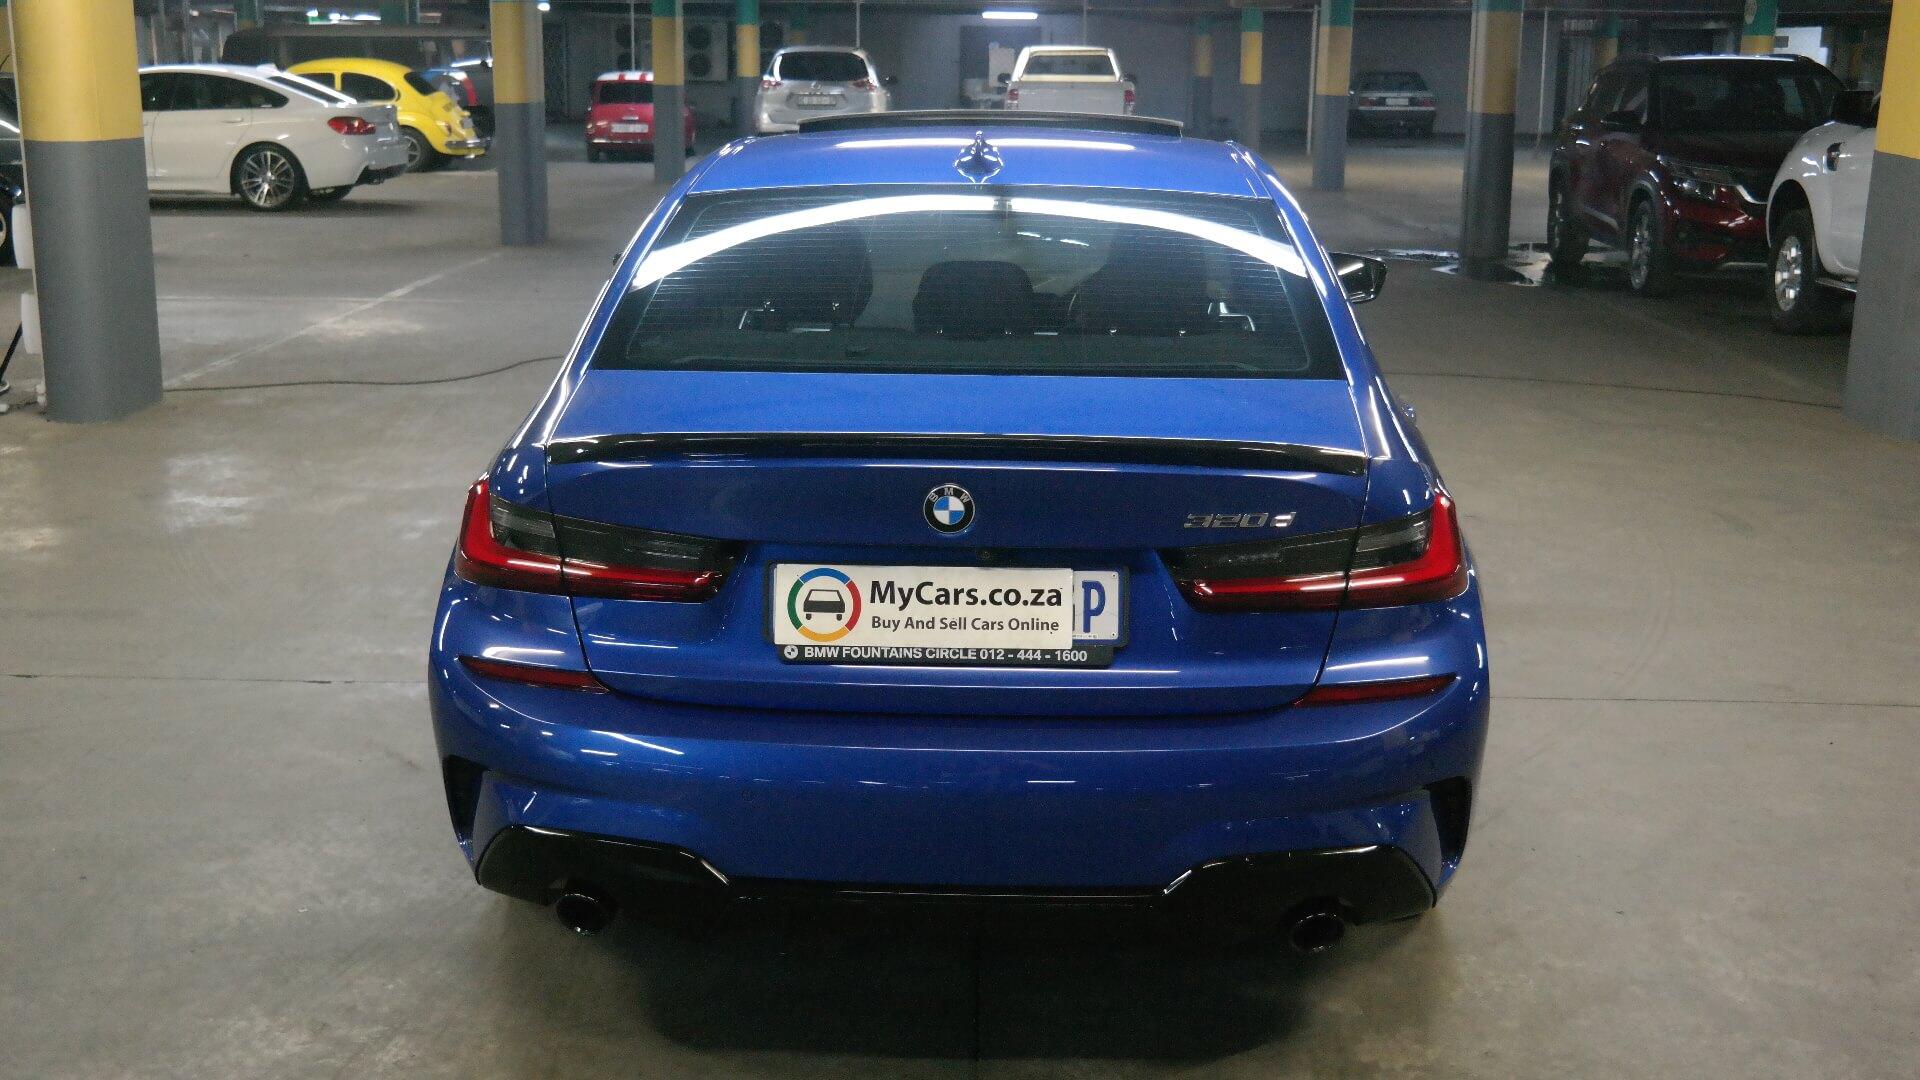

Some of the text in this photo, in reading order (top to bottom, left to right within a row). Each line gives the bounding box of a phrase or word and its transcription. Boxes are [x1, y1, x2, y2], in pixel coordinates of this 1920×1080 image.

[929, 487, 970, 502] BMW
[1184, 511, 1297, 528] 320d
[870, 580, 1062, 611] MyCars.co.za
[871, 616, 1060, 632] Buy And Sell Cars Online
[804, 646, 839, 658] BMW
[842, 646, 923, 659] FOUNTAINS
[925, 648, 977, 660] CIRCLE
[979, 649, 1005, 660] 012
[1016, 650, 1042, 661] 444
[1055, 650, 1088, 662] 1600
